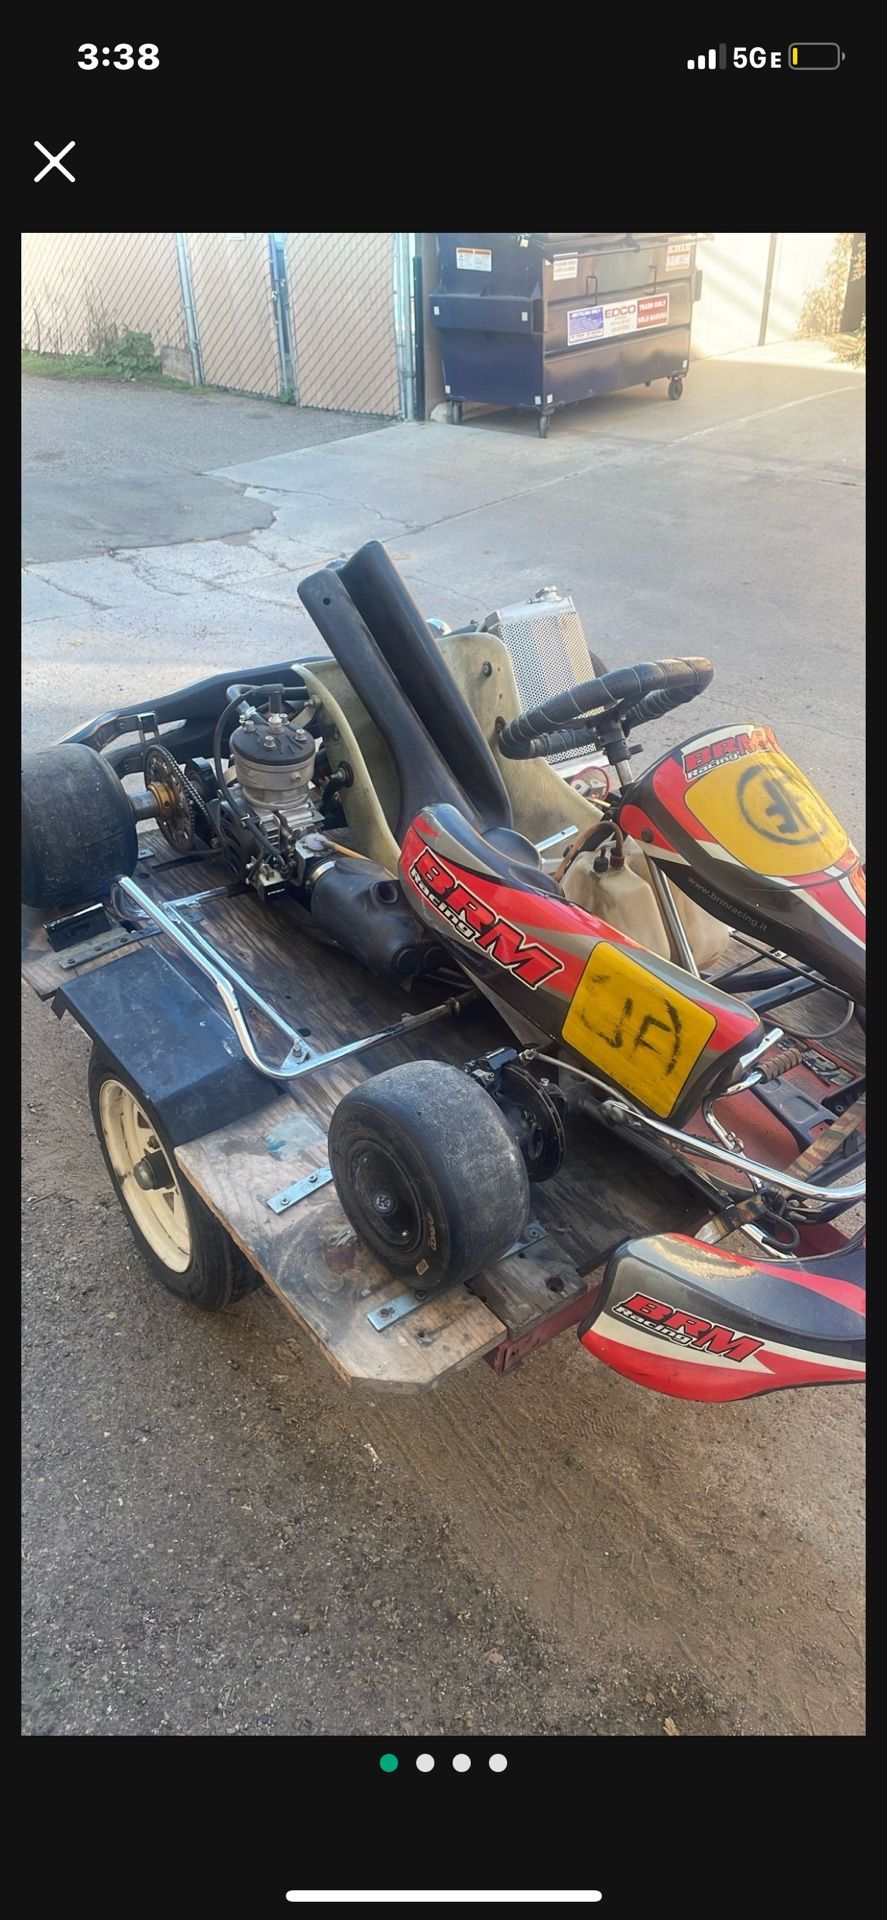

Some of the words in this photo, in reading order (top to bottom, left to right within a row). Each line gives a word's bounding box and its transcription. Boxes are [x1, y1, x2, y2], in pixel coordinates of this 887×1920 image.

[605, 305, 636, 318] EDCO
[684, 731, 777, 773] BRM
[687, 753, 738, 780] Racing
[409, 866, 477, 941] Racing
[415, 850, 562, 985] BRM
[687, 874, 768, 932] www.brmracing.it
[613, 1305, 695, 1345] Racing
[622, 1293, 765, 1363] BRM
